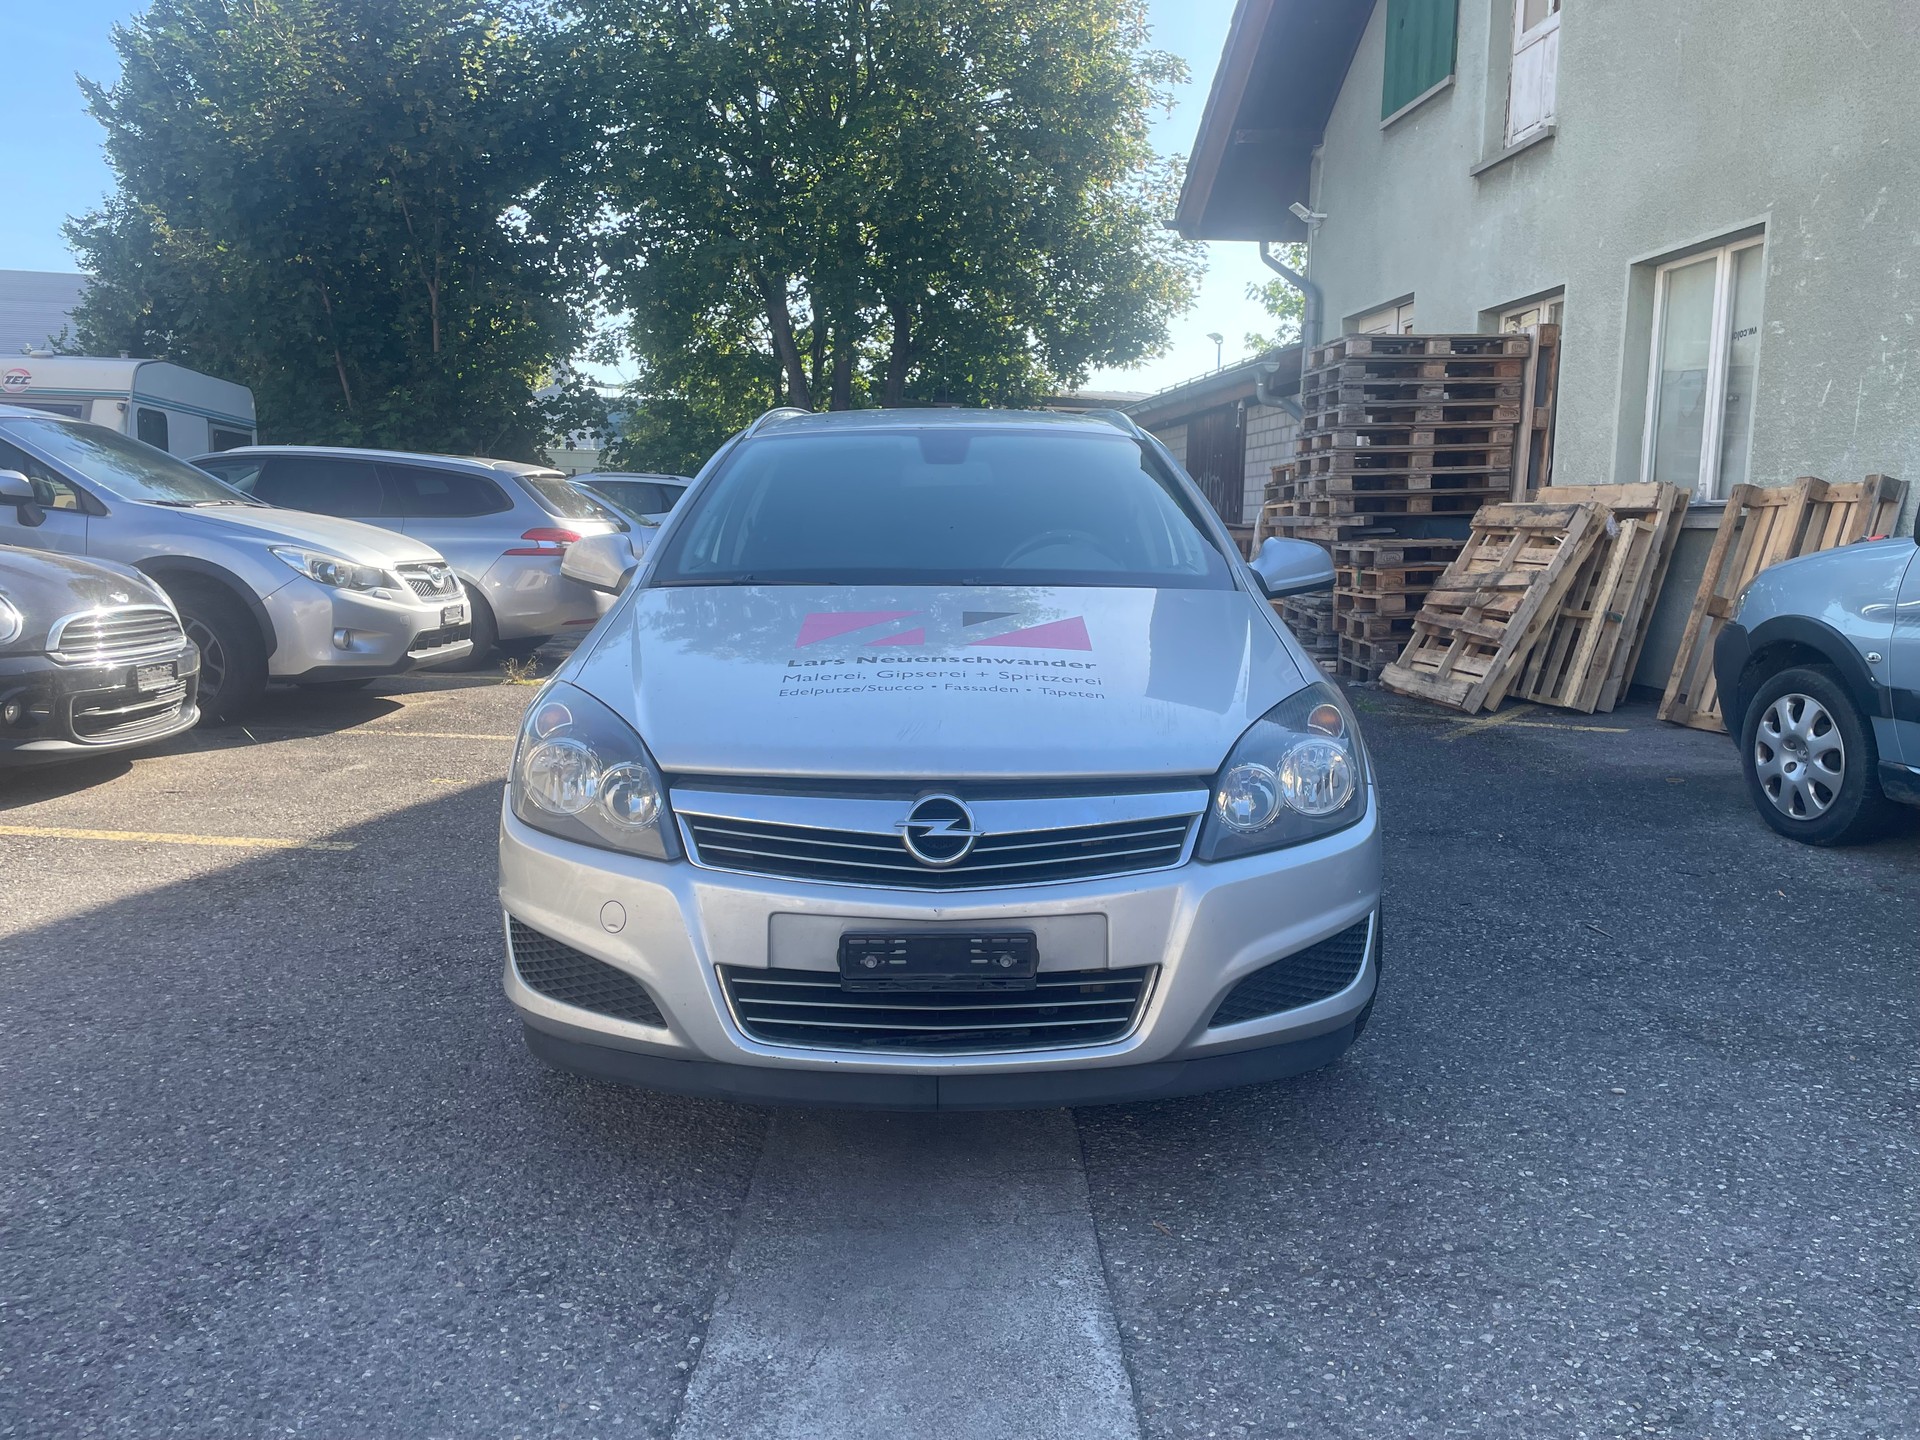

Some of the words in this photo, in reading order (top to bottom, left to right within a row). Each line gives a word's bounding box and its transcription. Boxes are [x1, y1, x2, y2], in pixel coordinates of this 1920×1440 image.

[4, 375, 32, 385] TEC
[787, 658, 846, 668] Lars
[856, 656, 1097, 669] Neuenschwander
[782, 672, 867, 684] Malerei,
[876, 670, 967, 681] Gipserei
[998, 671, 1102, 686] Spritzerei
[779, 684, 924, 697] Edelputze/Stucco
[944, 683, 1020, 694] Fassaden
[1039, 687, 1105, 699] Tapeten
